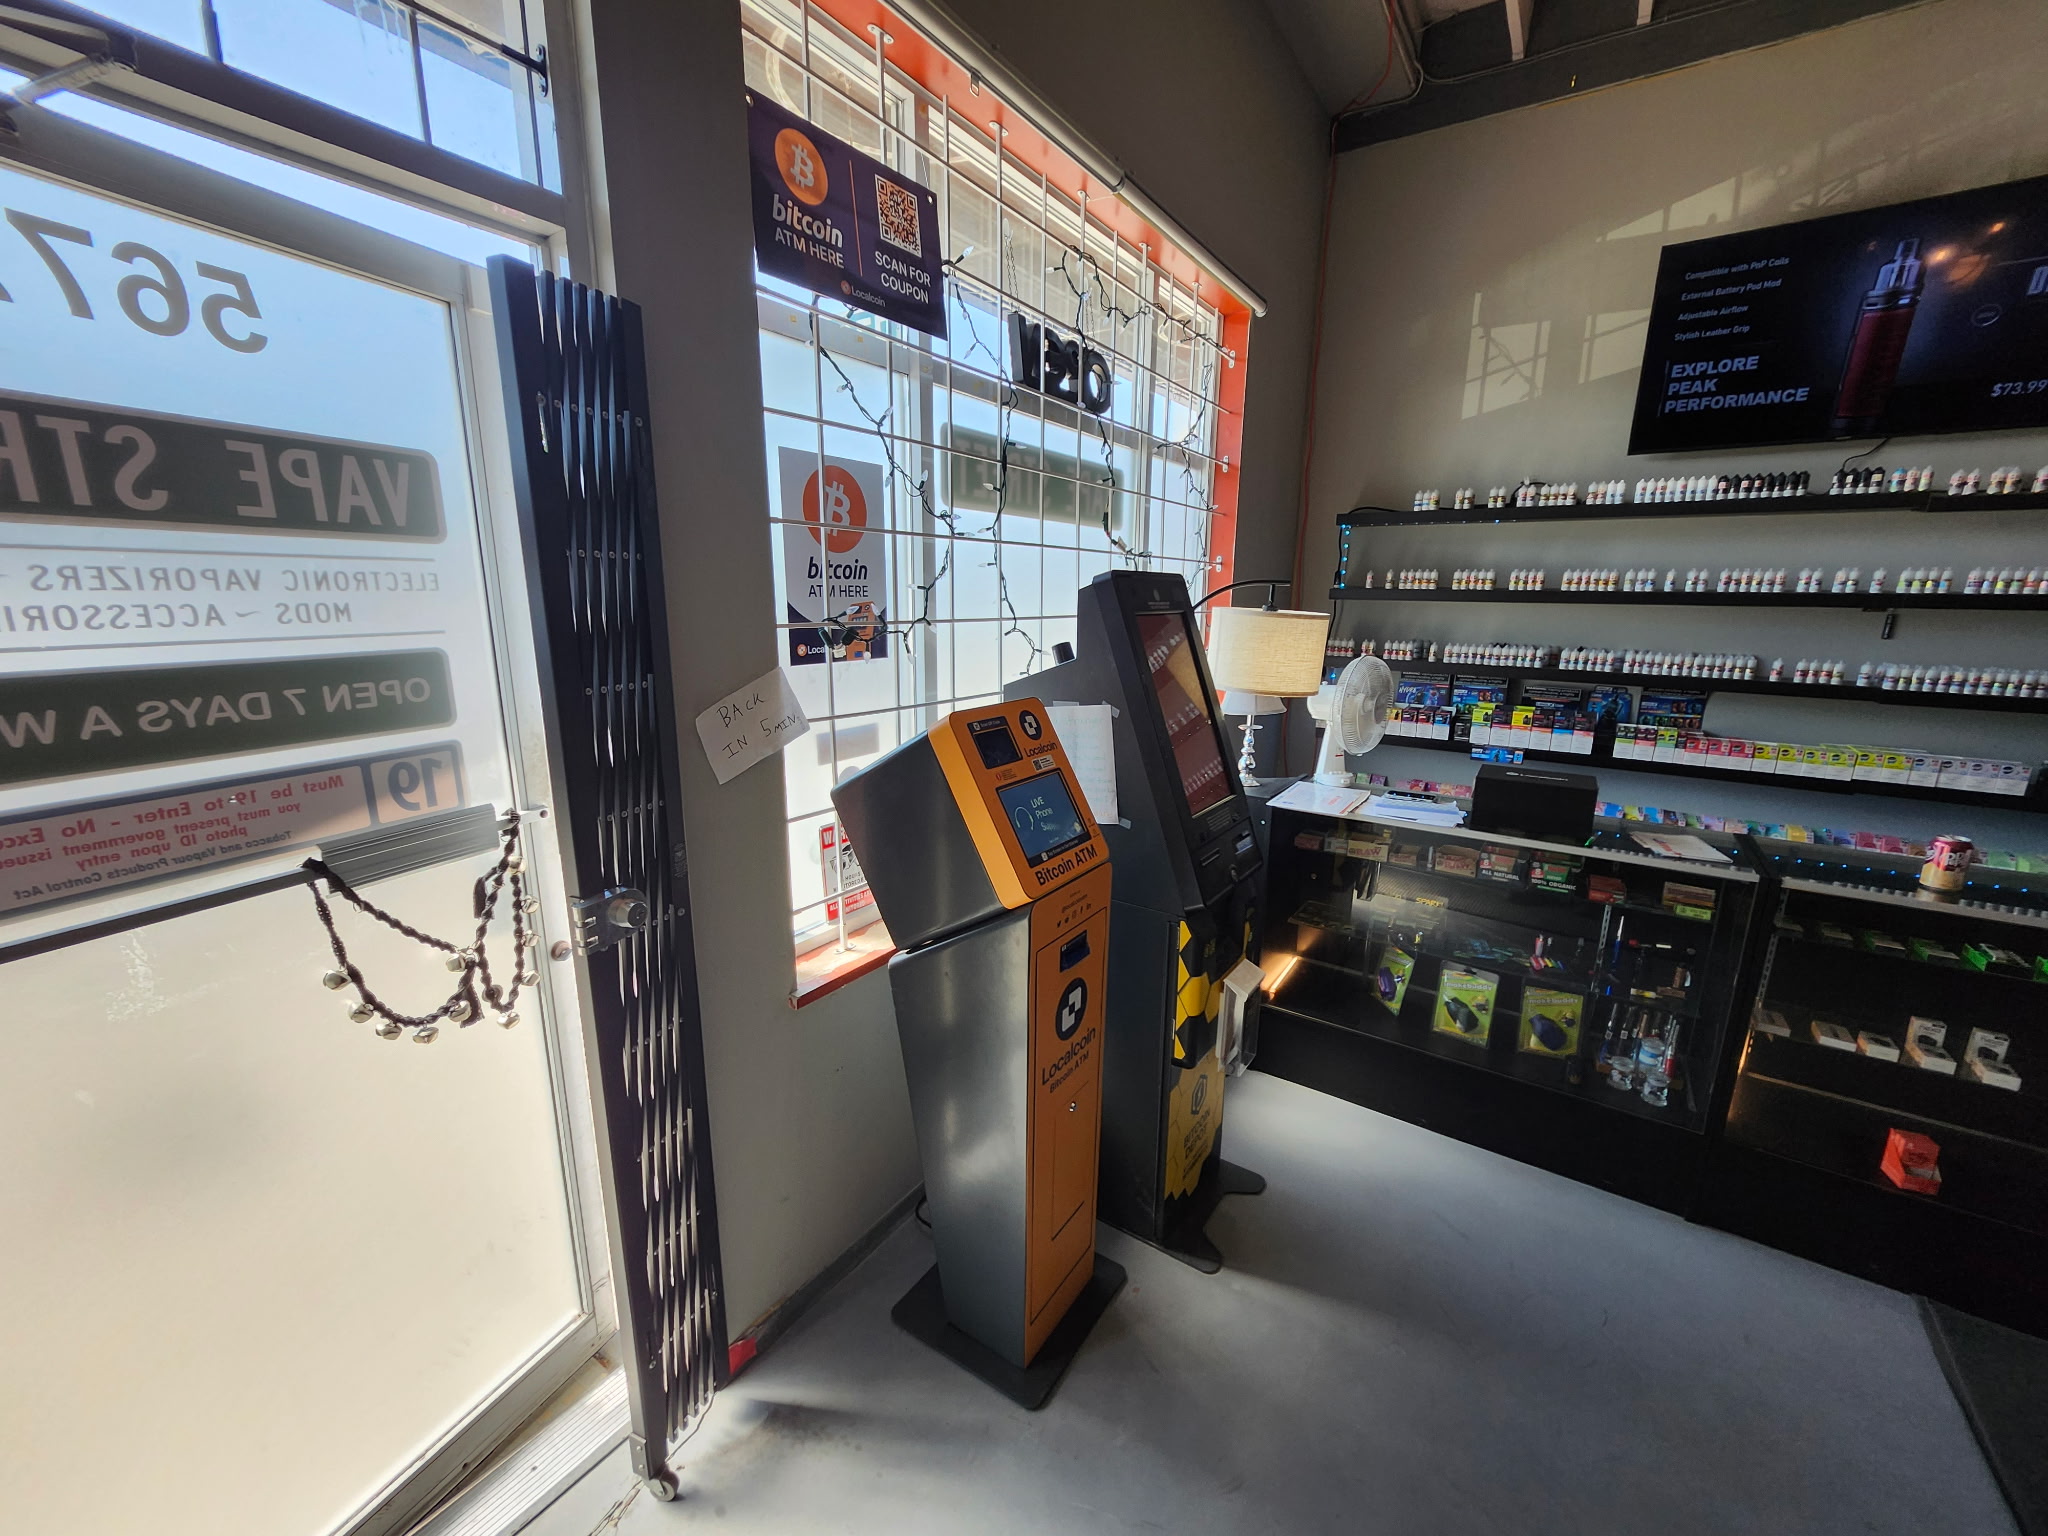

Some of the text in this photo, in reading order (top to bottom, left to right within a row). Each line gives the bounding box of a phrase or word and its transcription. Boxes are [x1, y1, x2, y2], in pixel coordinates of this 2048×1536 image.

[772, 194, 843, 248] bitcoin
[775, 227, 845, 269] ATM HERE
[875, 251, 931, 287] SCAN FOR
[1685, 267, 1729, 280] Compatible
[1731, 264, 1749, 273] with
[1768, 257, 1790, 267] Coils
[851, 285, 886, 308] Localcoin
[880, 273, 929, 304] COUPON
[1681, 279, 1782, 301] External Battery Pod Mod
[1678, 305, 1749, 321] Adjustable Airflow
[1675, 325, 1750, 341] Stylish Leather Grip
[1671, 356, 1759, 378] EXPLORE
[1668, 379, 1719, 396] PEAK
[1664, 387, 1810, 413] PERFORMANCE
[839, 585, 869, 598] HERE
[716, 692, 764, 728] BACK
[722, 735, 748, 759] IN
[1023, 741, 1058, 757] Localcoin
[1030, 796, 1045, 808] LIVE
[1035, 807, 1053, 819] Phone
[1034, 857, 1075, 886] Bitcoin
[1075, 844, 1098, 867] ATM
[1493, 871, 1520, 881] NATURAL
[1548, 881, 1577, 891] ORGANIC
[1042, 1027, 1096, 1086] Localcoin
[1050, 1050, 1089, 1094] Bitcoin ATM
